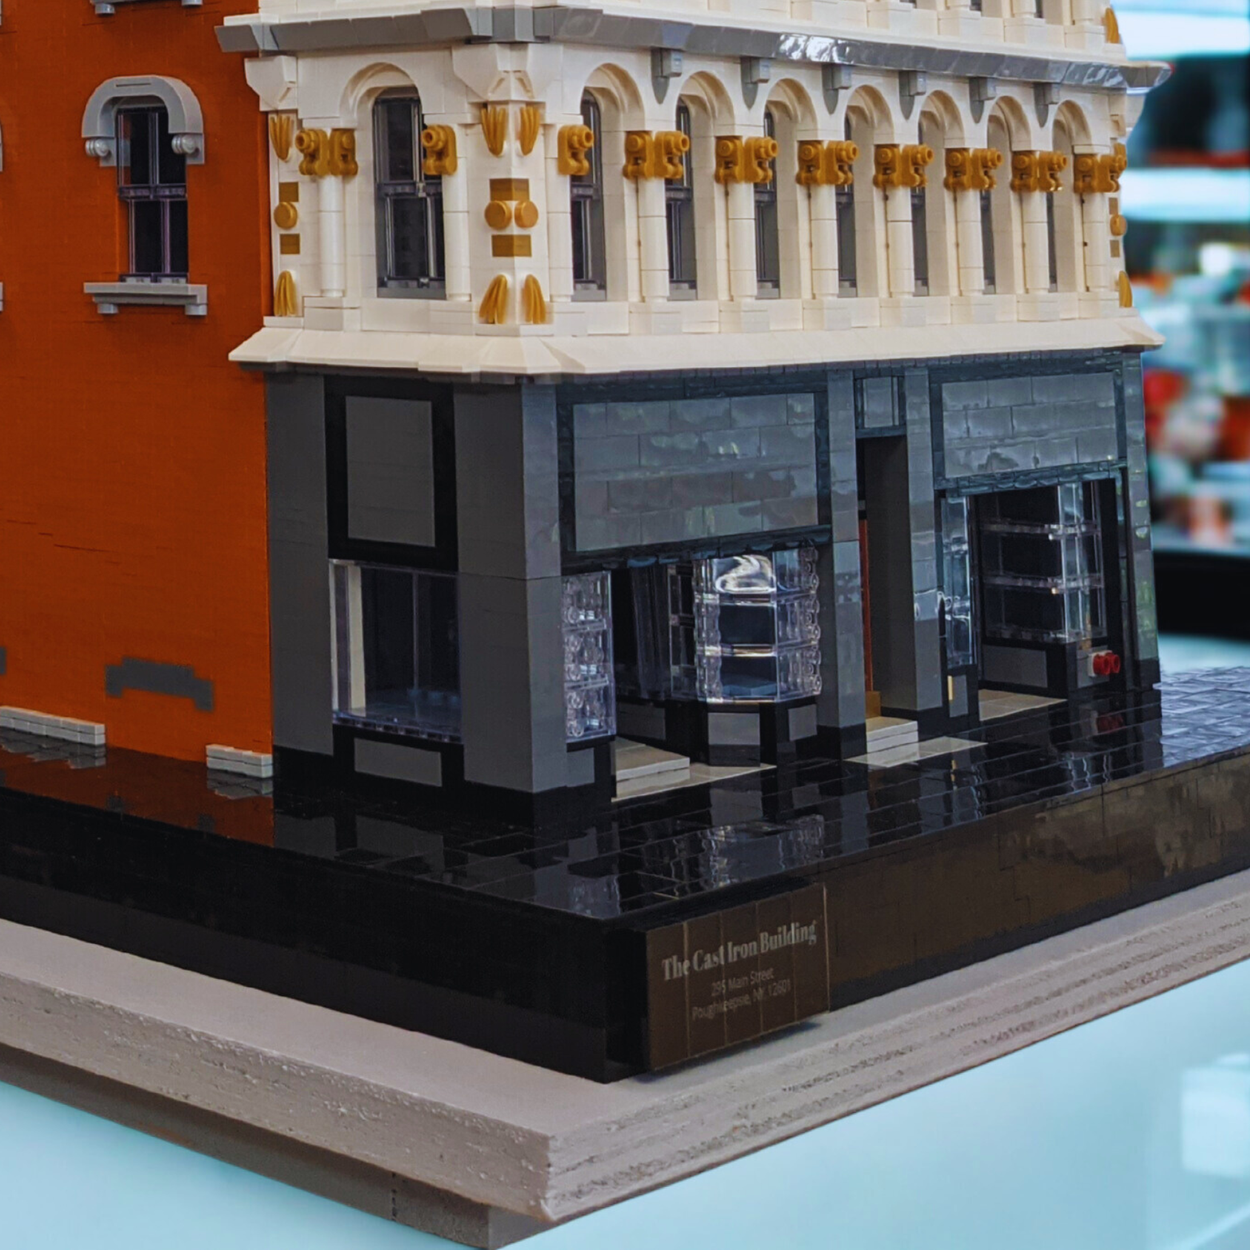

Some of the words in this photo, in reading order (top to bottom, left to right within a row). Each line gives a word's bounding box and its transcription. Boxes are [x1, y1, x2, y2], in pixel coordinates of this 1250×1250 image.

[661, 954, 691, 981] The
[693, 944, 725, 972] Cast
[727, 940, 758, 963] Iron
[759, 920, 818, 954] Building
[728, 975, 749, 992] Main
[749, 967, 775, 985] Street
